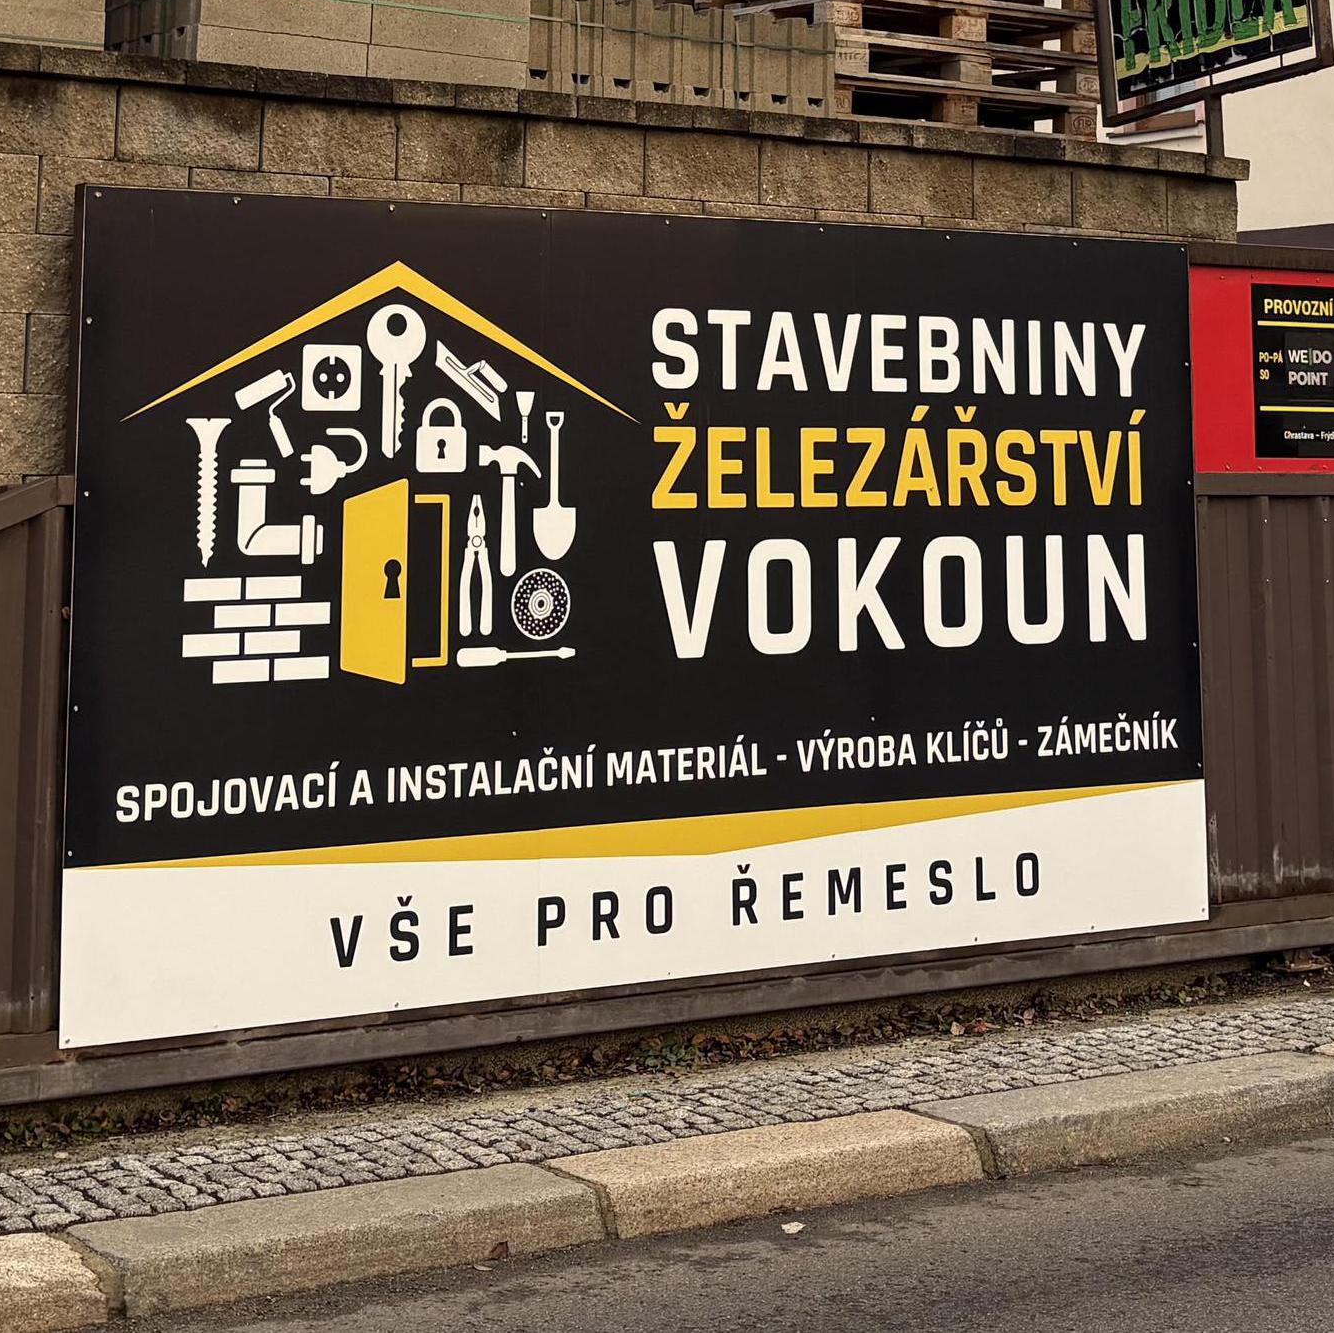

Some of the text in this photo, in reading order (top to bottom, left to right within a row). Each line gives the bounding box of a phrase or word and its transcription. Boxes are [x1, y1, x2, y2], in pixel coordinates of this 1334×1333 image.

[651, 307, 1146, 398] STAVEBNINY
[1258, 350, 1284, 363] PO-PÁ
[1263, 298, 1334, 317] PROVOZNÍ
[1259, 368, 1270, 380] SO
[1288, 371, 1329, 386] POINT
[651, 402, 1147, 509] ŽELEZÁŘSTVÍ
[652, 533, 1147, 659] VOKOUN
[115, 760, 340, 823] SPOJOVACÍ
[349, 769, 374, 806] A
[387, 743, 596, 803] INSTALAČNÍ
[606, 734, 767, 787] MATERIÁL
[796, 728, 917, 773] VÝROBA
[926, 717, 1009, 764] KLÍČŮ
[1037, 710, 1179, 757] ZÁMEČNÍK
[330, 852, 1040, 968] VŠE PRO ŘEMESLO
